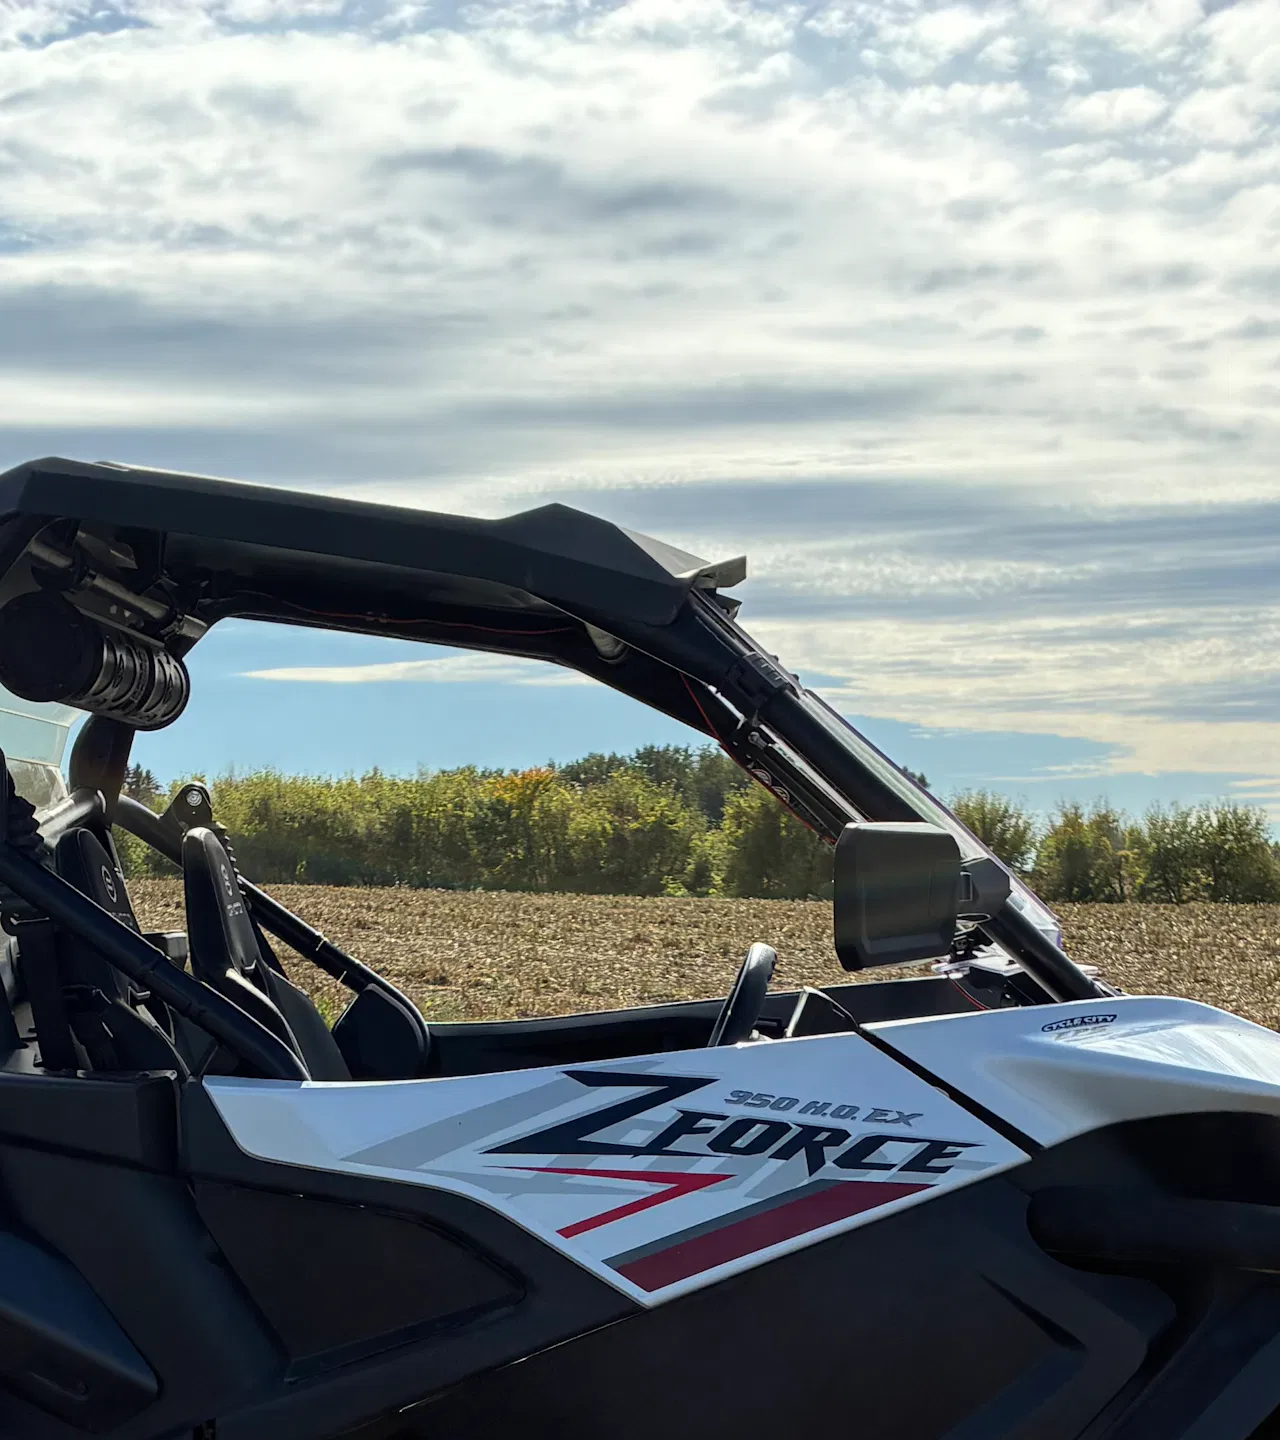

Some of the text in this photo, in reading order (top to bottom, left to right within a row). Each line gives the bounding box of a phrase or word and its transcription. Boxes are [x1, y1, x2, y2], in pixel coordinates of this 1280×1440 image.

[724, 1089, 923, 1127] 950 H.O. EX
